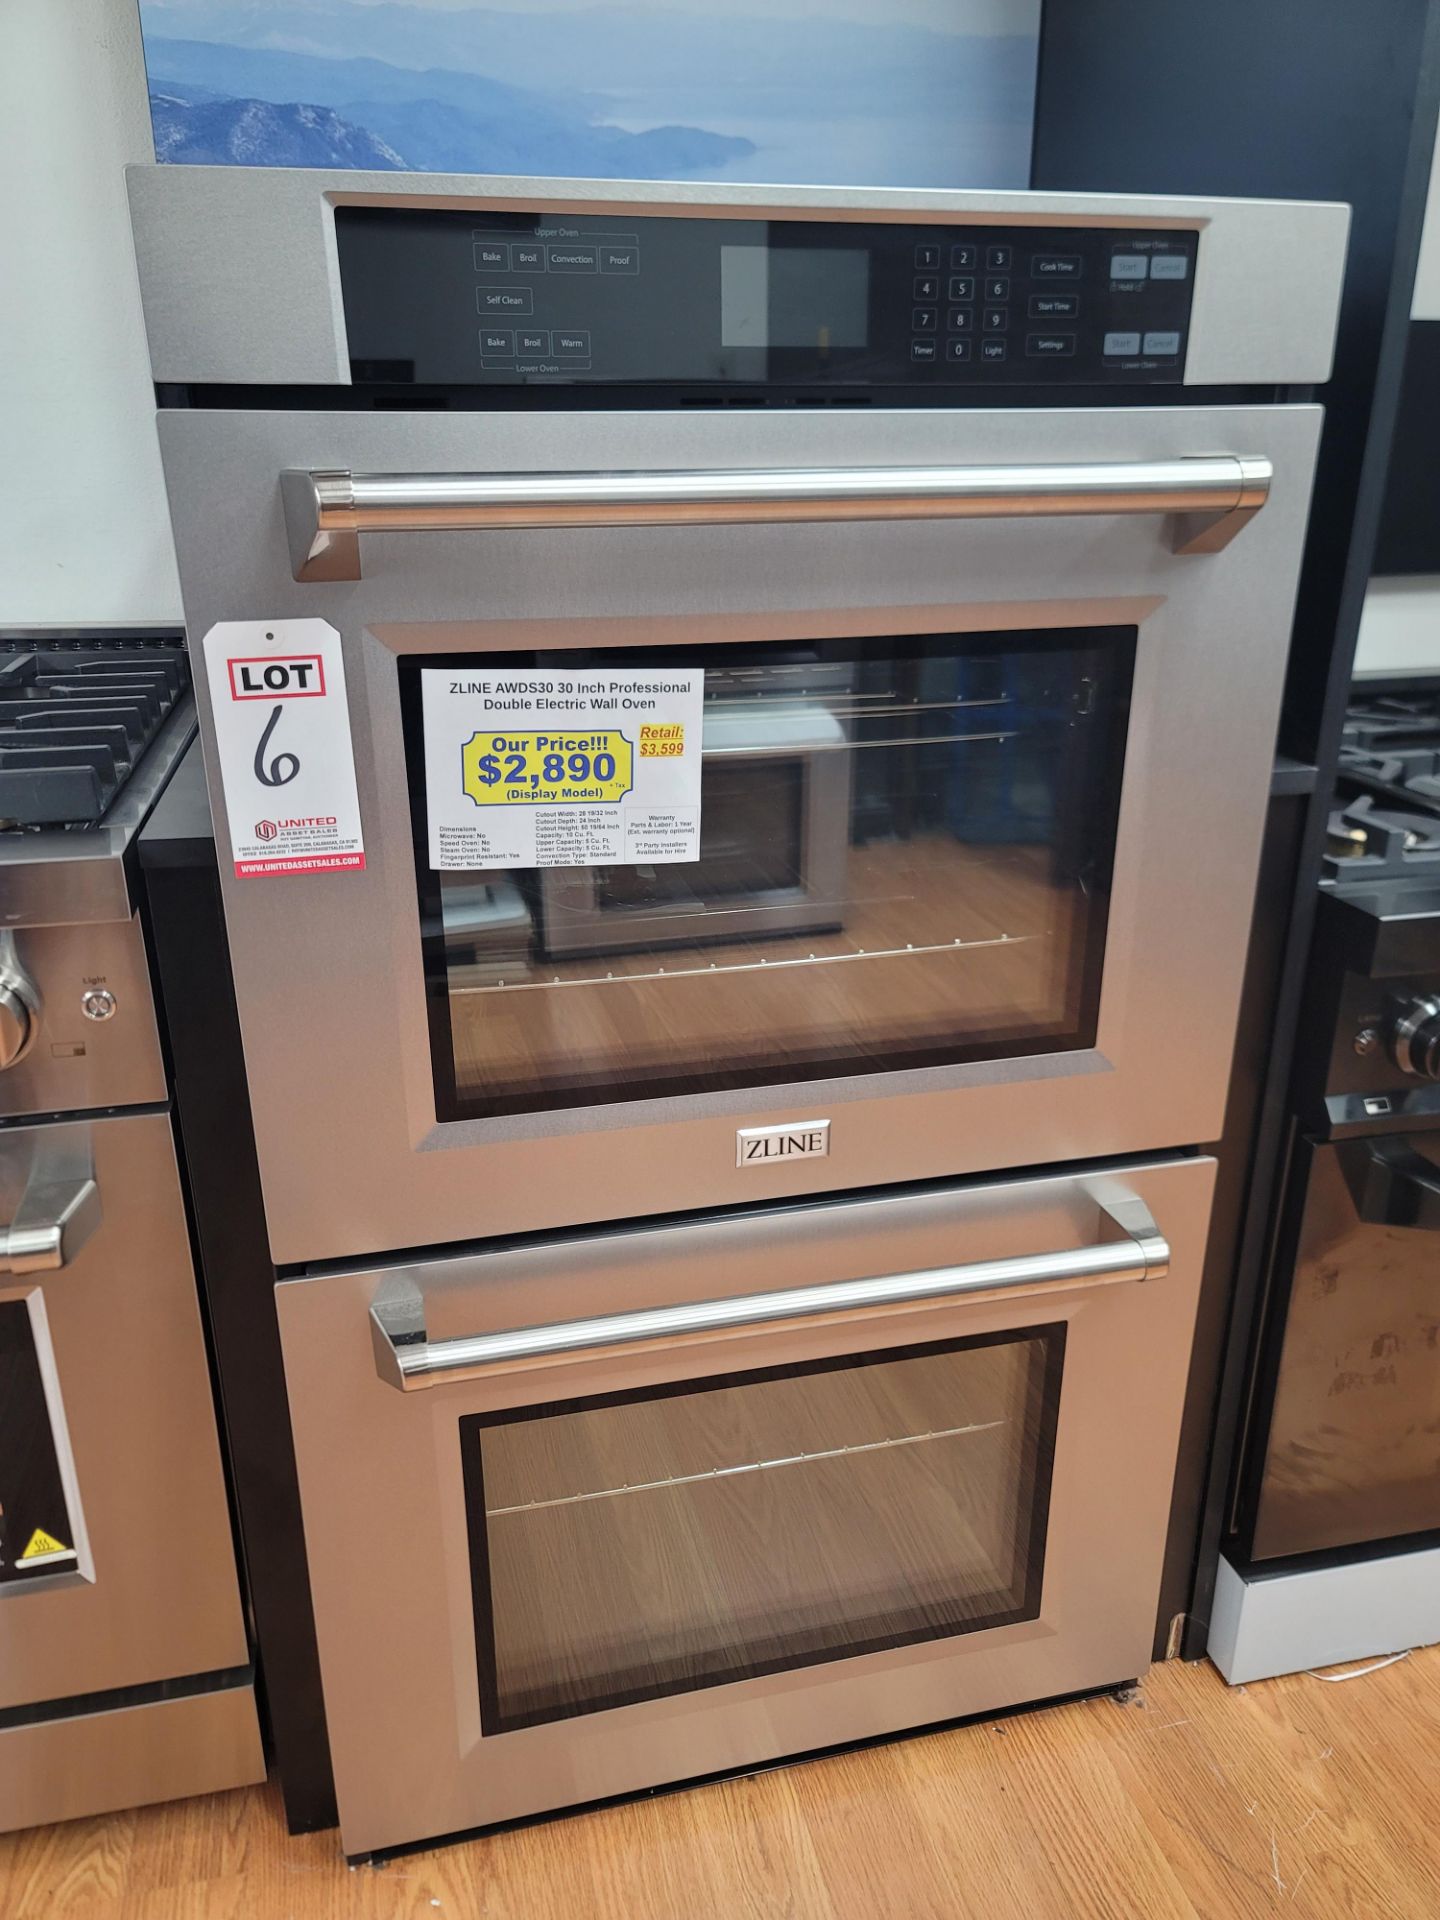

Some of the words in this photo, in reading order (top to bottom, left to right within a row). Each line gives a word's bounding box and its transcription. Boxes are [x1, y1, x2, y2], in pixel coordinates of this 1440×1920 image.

[534, 228, 558, 238] Upper
[559, 228, 579, 237] Oven
[482, 252, 502, 261] Bake
[520, 254, 537, 262] Broil
[551, 254, 593, 264] Convection
[609, 256, 630, 264] Proof
[926, 251, 930, 264] 1
[960, 252, 968, 264] 2
[996, 252, 1003, 264] 3
[1040, 264, 1056, 272] Cook
[1058, 264, 1074, 272] Time
[922, 283, 930, 294] 4
[958, 284, 966, 294] 5
[994, 284, 1002, 294] 6
[486, 296, 500, 304] Self
[502, 296, 523, 304] Clean
[1054, 302, 1070, 310] Time
[922, 314, 928, 326] 7
[957, 314, 964, 326] 8
[992, 315, 1000, 326] 9
[487, 338, 506, 346] Bake
[524, 338, 541, 347] Broil
[560, 340, 583, 348] Warm
[914, 346, 934, 355] Timer
[955, 344, 962, 355] 0
[985, 346, 1002, 357] Light
[516, 364, 538, 372] Lower
[540, 364, 559, 372] Oven
[240, 664, 313, 691] LOT
[450, 682, 492, 694] ZLINE
[495, 682, 554, 694] AWDS30
[558, 682, 574, 694] 30
[577, 682, 605, 694] Inch
[609, 682, 691, 694] Professional
[484, 699, 532, 710] Double
[536, 698, 586, 710] Electric
[590, 698, 618, 710] Wall
[622, 698, 656, 709] Oven
[640, 726, 684, 740] Retail:
[254, 704, 300, 786] 6
[492, 737, 530, 752] Our
[536, 736, 608, 752] Price!!!
[640, 743, 684, 757] $3,599
[478, 753, 616, 790] $2,890
[506, 789, 558, 800] (Display
[562, 788, 603, 799] Model)
[278, 816, 336, 828] UNITED
[241, 857, 360, 873] WWW.UNITEDASSETSALES.COM
[82, 976, 106, 985] Light
[746, 1132, 822, 1160] ZLINE
